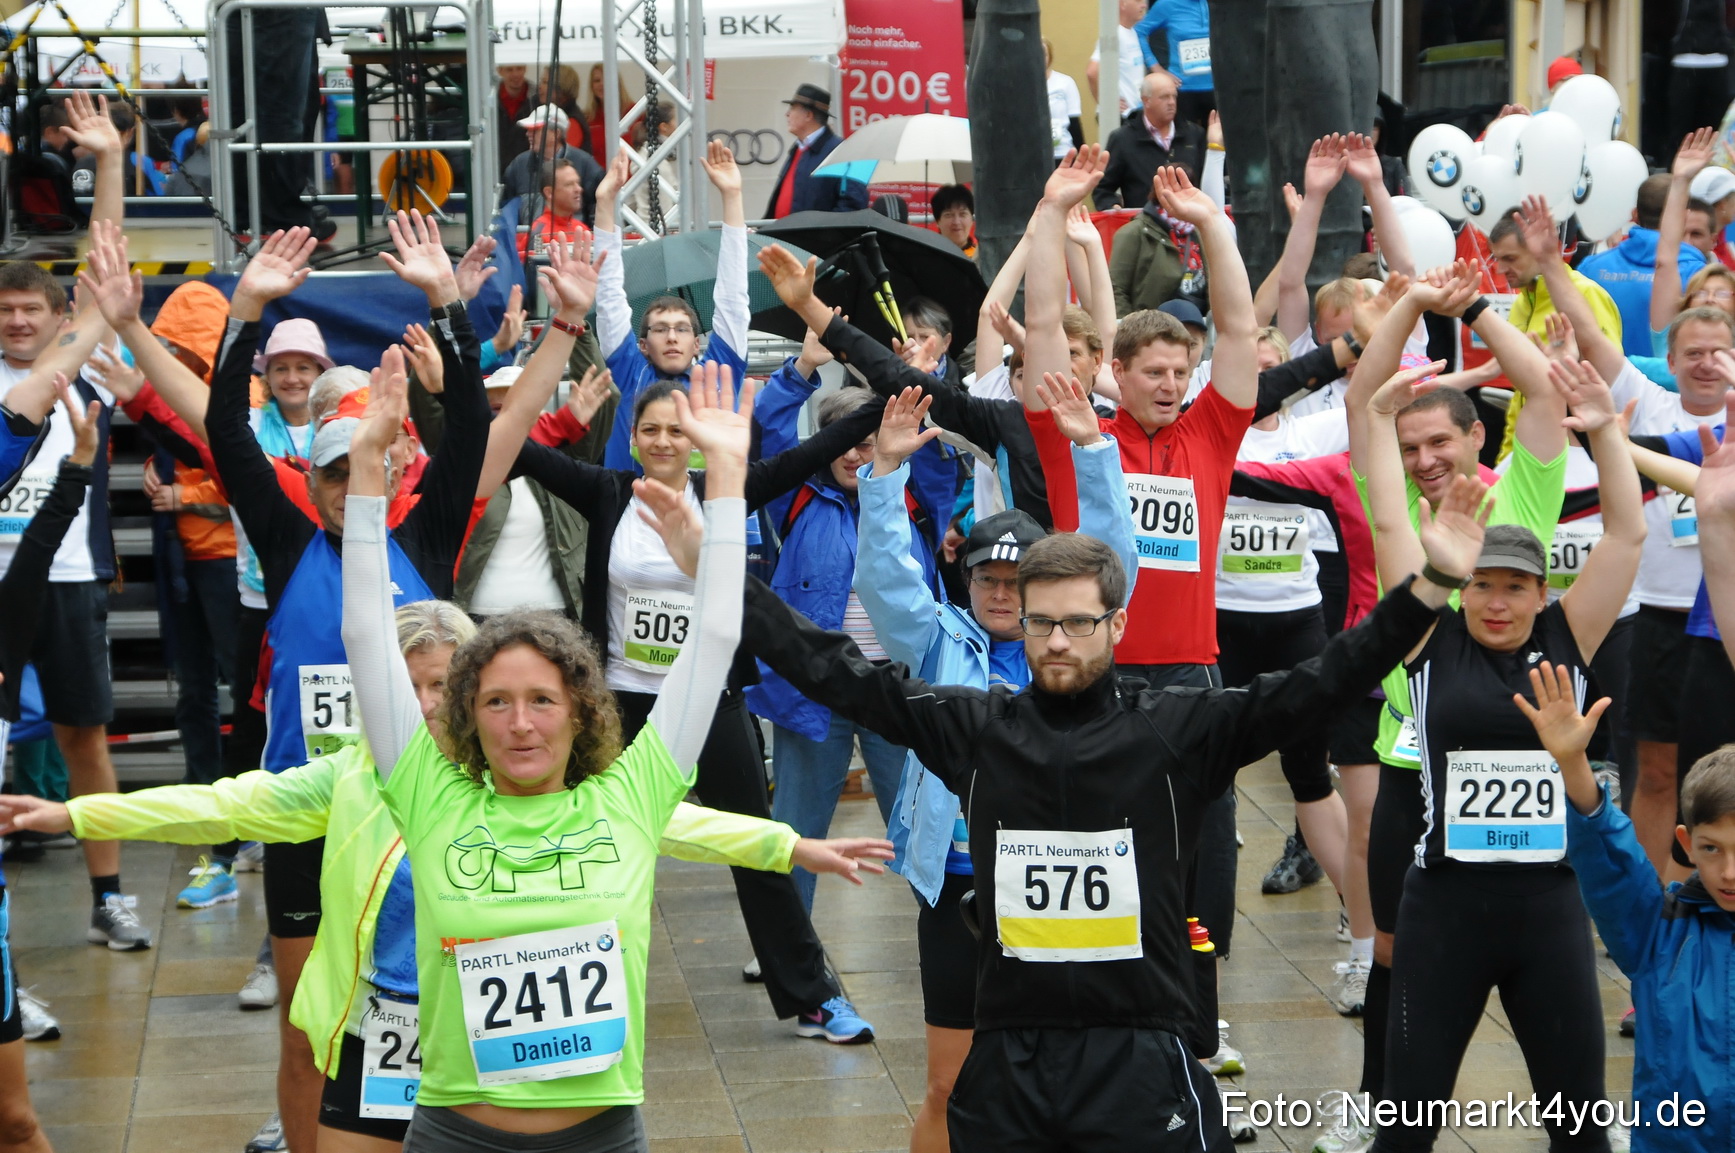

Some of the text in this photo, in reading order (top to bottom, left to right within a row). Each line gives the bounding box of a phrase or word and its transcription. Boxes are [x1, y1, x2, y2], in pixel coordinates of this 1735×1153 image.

[503, 20, 546, 40] für
[636, 16, 707, 38] ui
[719, 14, 794, 36] BKK.
[848, 25, 905, 37] Noch mehr,
[848, 37, 922, 48] noch einfacher.
[1184, 46, 1211, 60] 235
[80, 63, 118, 75] Aui
[1599, 269, 1628, 281] Team
[1127, 482, 1189, 496] RTL Neumar
[1253, 514, 1292, 523] Neumarkt
[1230, 524, 1299, 552] 5017
[1136, 540, 1179, 557] Roland
[1244, 559, 1282, 571] Sandra
[628, 595, 694, 611] PARTL Neumar
[648, 648, 680, 664] Moni
[302, 675, 339, 686] PARTL
[1450, 762, 1547, 773] PARTL Neumarkt
[1459, 778, 1555, 819] 2229
[1486, 829, 1531, 850] Birgit
[999, 844, 1110, 857] PARTL Neumarkt
[603, 891, 626, 899] GmbH
[1024, 864, 1110, 912] 576
[461, 953, 514, 973] PARTL
[516, 941, 591, 964] Neumarkt
[479, 960, 613, 1031] 2412
[371, 1009, 411, 1027] PARTL
[512, 1032, 592, 1063] Daniela
